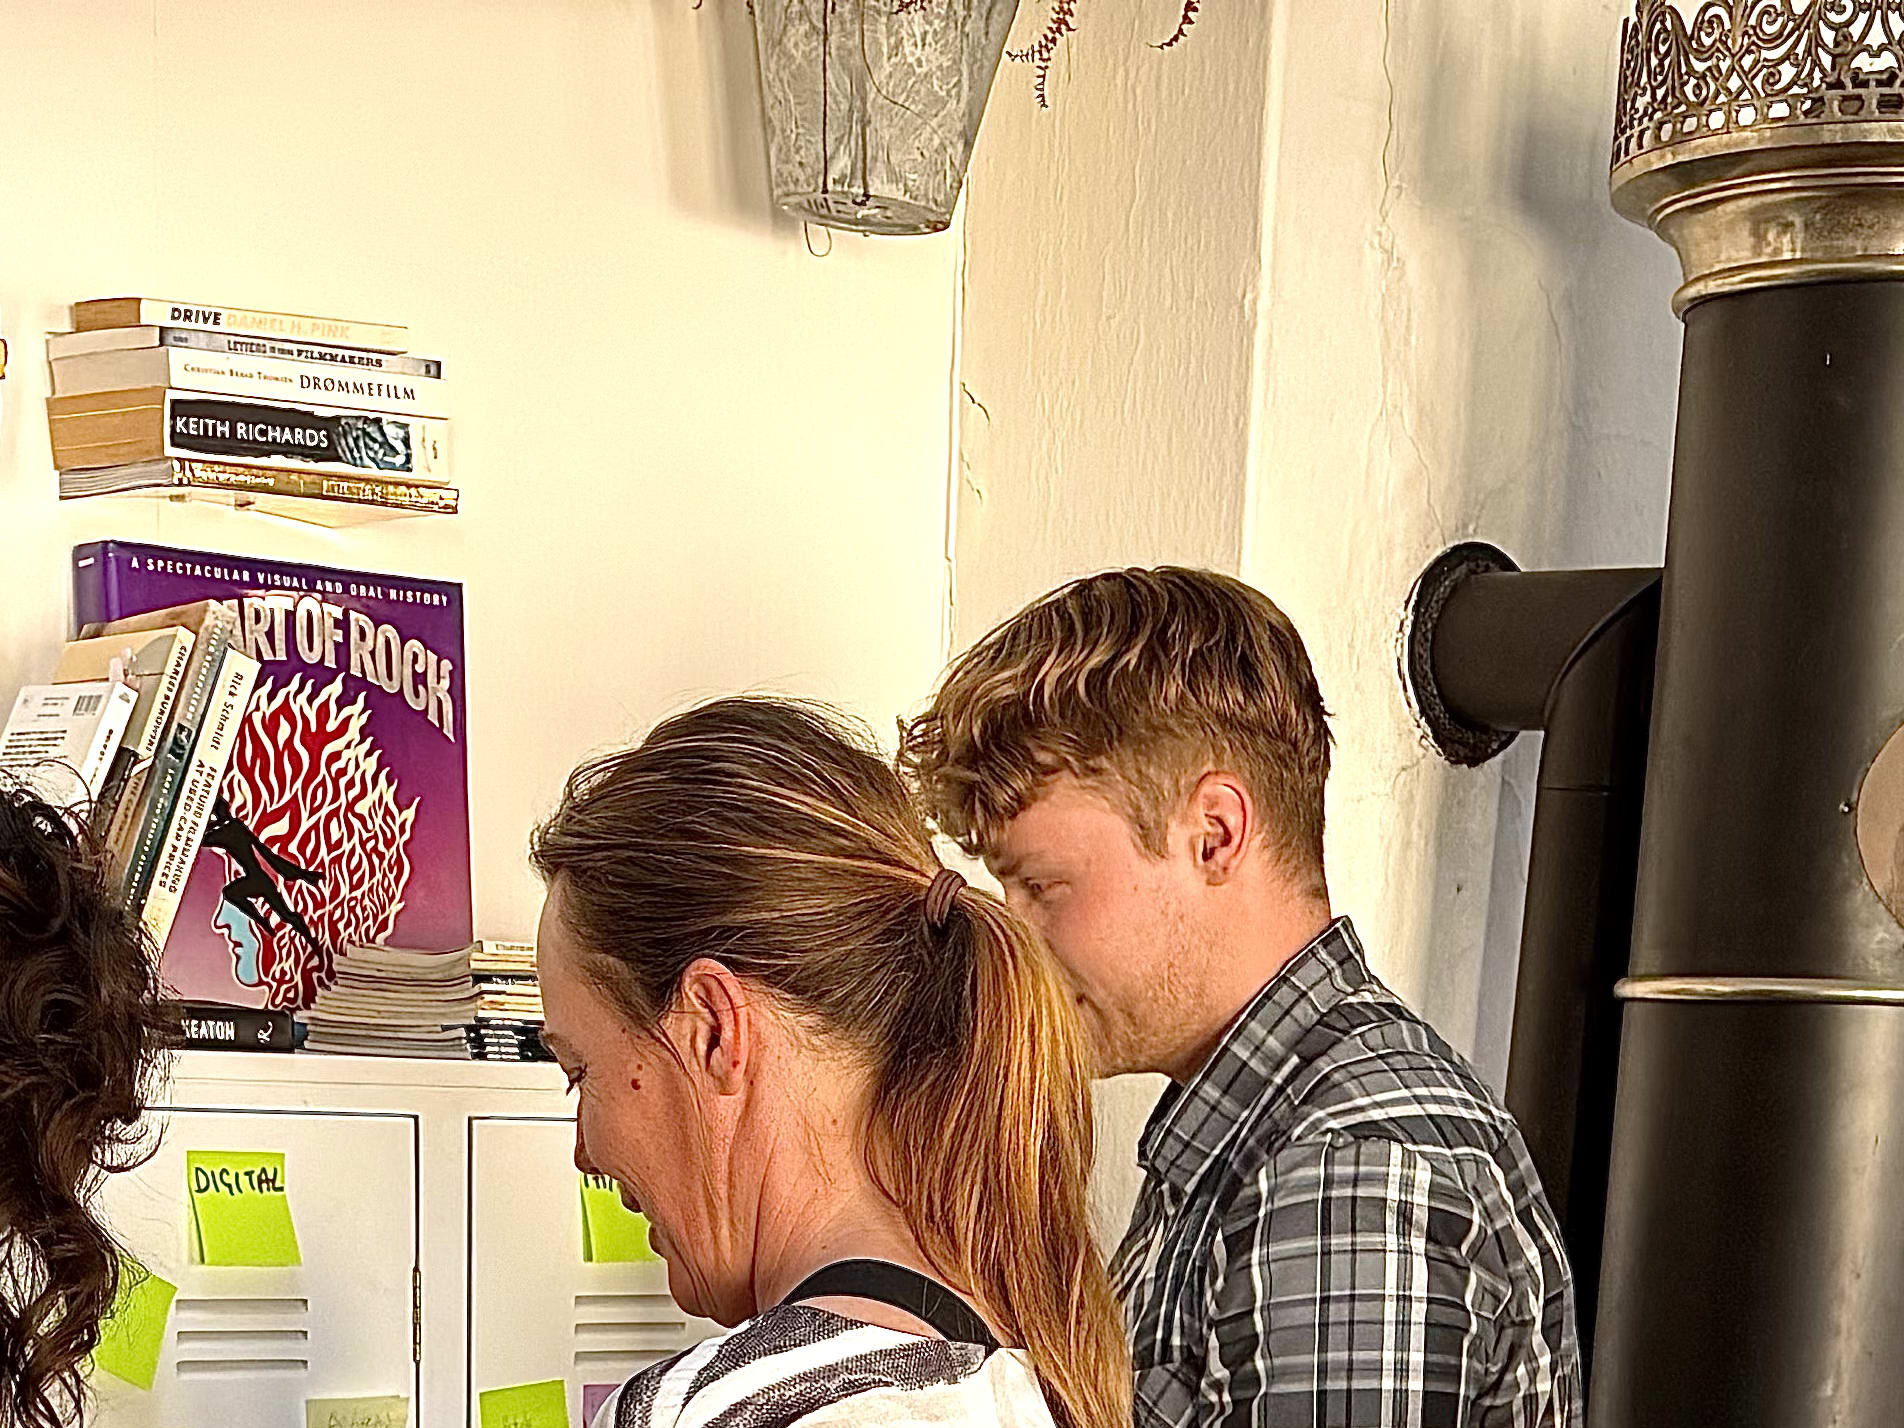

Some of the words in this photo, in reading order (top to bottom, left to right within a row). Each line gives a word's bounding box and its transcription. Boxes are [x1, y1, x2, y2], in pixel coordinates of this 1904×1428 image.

[170, 307, 222, 326] DRIVE
[226, 312, 285, 332] DANIEL
[311, 320, 352, 339] PINK
[296, 349, 383, 368] FILMMAKERS
[299, 374, 416, 401] DRØMMEFILM
[175, 416, 230, 439] KEITH
[236, 421, 329, 448] RICHARDS
[131, 556, 140, 569] A
[147, 558, 250, 582] SPECTACULAR
[257, 571, 308, 590] VISUAL
[315, 579, 343, 594] AND
[350, 583, 383, 600] ORAL
[389, 588, 449, 607] HISTORY
[295, 596, 344, 669] OF
[348, 609, 456, 744] ROCK
[209, 702, 235, 752] Schmidt
[194, 1166, 285, 1196] DIGITAL
